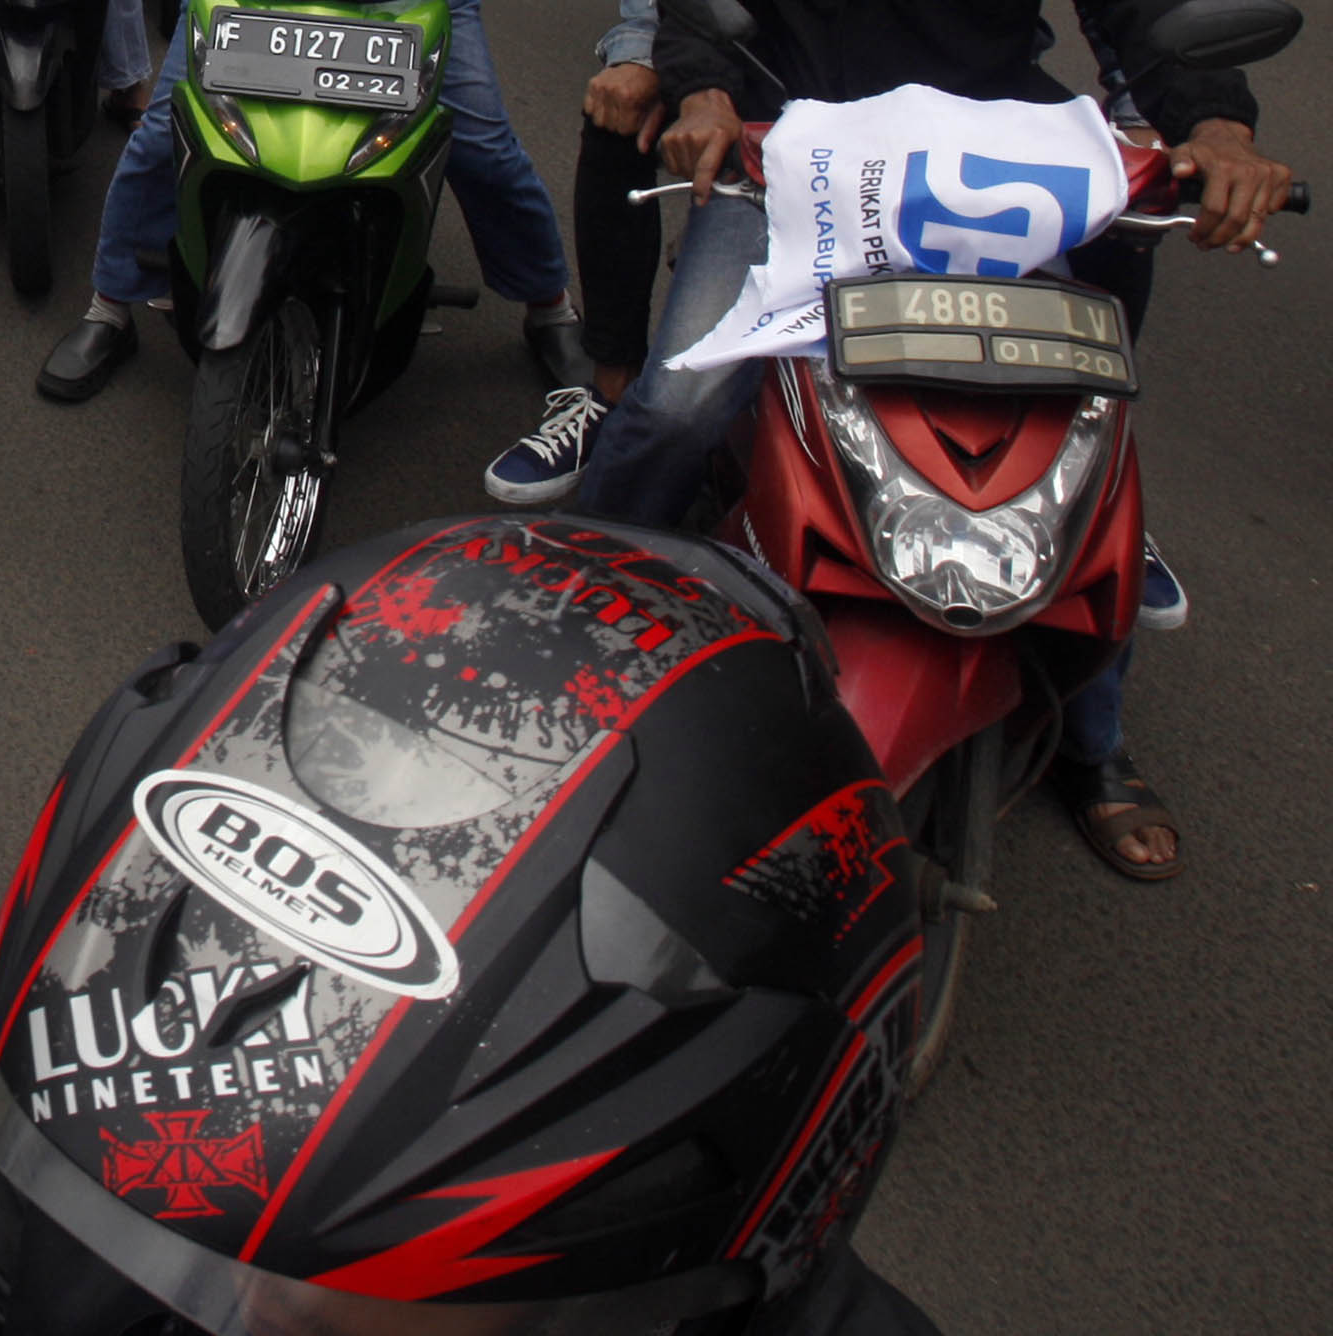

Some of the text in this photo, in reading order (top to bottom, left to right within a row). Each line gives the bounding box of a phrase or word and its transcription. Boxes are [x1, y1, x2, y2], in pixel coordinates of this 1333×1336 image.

[220, 22, 403, 65] F 6127 CT
[810, 148, 832, 192] DPC
[859, 159, 886, 230] SERIKAT
[843, 287, 1106, 340] F 4886 LV
[198, 800, 373, 928] BOS
[201, 842, 328, 927] HELMET
[26, 960, 315, 1083] LUCKY
[29, 1052, 325, 1125] NINETEEN
